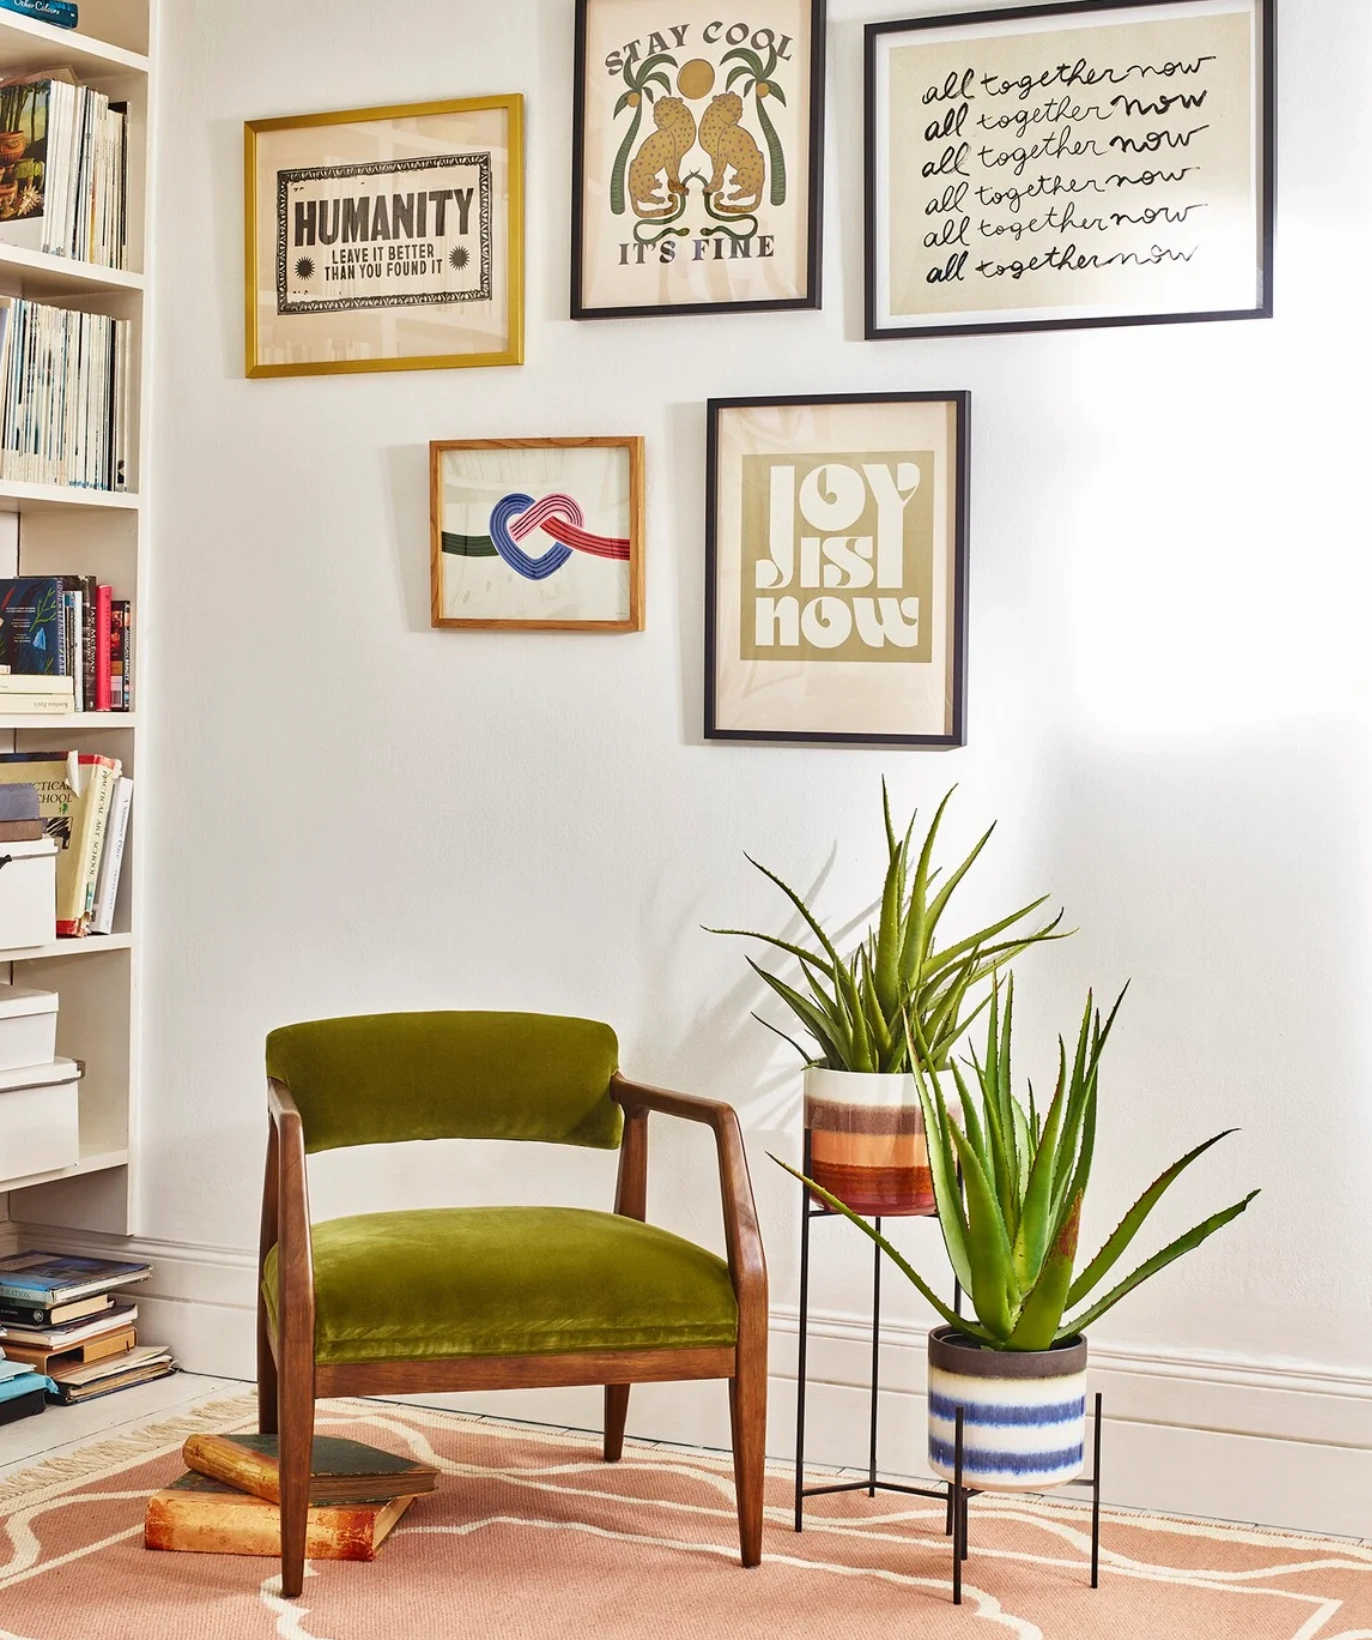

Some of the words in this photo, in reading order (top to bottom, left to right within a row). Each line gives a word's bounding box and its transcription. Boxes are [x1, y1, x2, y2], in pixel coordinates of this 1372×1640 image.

[604, 24, 690, 76] STAY
[703, 21, 794, 61] COOL
[922, 68, 975, 104] all
[981, 58, 1127, 99] together
[1127, 56, 1217, 78] now
[924, 102, 969, 141] all
[977, 96, 1112, 138] together
[1110, 89, 1208, 116] now
[922, 142, 971, 177] all
[978, 126, 1108, 175] together
[1109, 124, 1209, 152] now
[925, 181, 970, 215] all
[975, 175, 1105, 212] together
[1105, 166, 1200, 187] now
[294, 188, 474, 247] HUMANITY
[923, 216, 970, 247] all
[978, 202, 1108, 241] together
[1110, 203, 1208, 226] now
[325, 265, 355, 281] THAN
[360, 263, 382, 279] YOU
[386, 260, 426, 278] FOUND
[431, 258, 443, 275] IT
[332, 247, 368, 264] LEAVE
[373, 246, 384, 262] IT
[388, 243, 434, 261] BETTER
[618, 241, 676, 265] IT'S
[692, 235, 775, 261] FINE
[926, 250, 969, 283] all
[975, 244, 1107, 279] together
[1104, 244, 1199, 265] now
[755, 462, 921, 589] JOY
[33, 781, 72, 790] CTICAL
[38, 793, 72, 803] HOOL
[90, 840, 99, 876] SCHOOL
